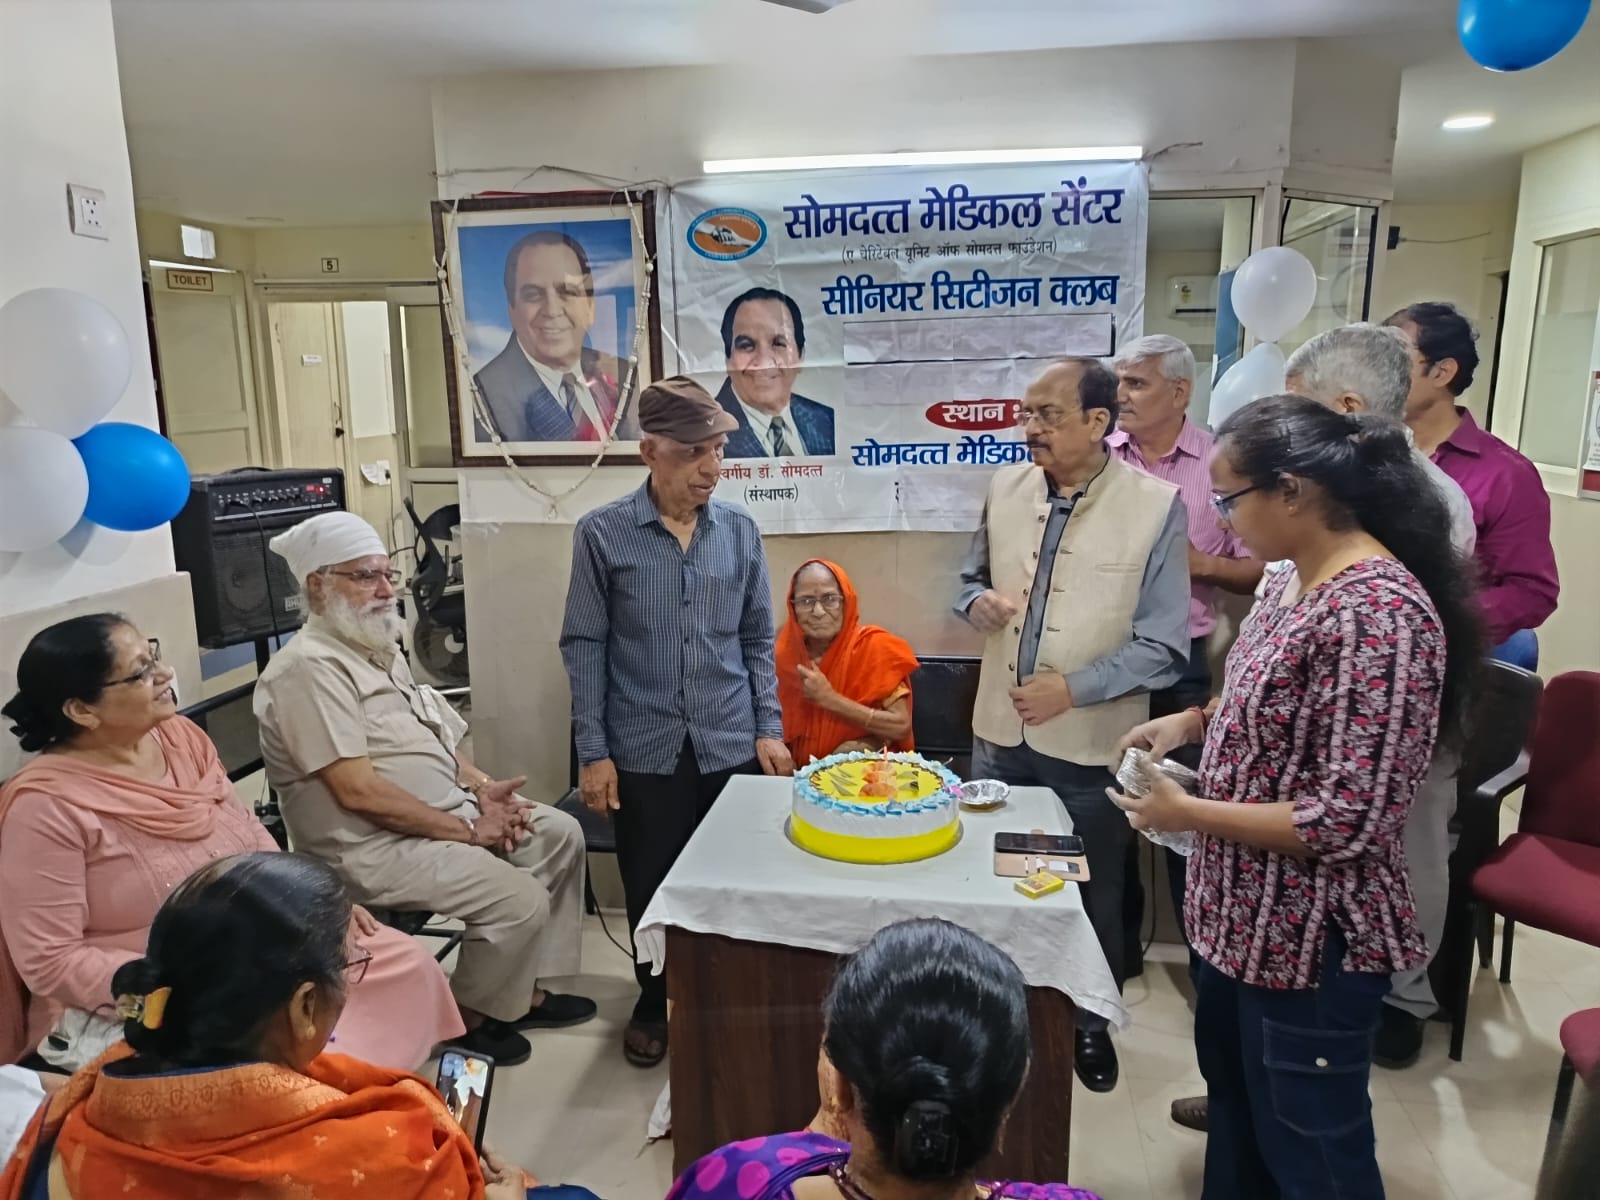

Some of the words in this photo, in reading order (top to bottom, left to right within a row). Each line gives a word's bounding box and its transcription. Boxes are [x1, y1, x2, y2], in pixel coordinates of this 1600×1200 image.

[783, 194, 911, 239] सोमदत्त
[919, 183, 1045, 232] मेडिकल
[1051, 175, 1125, 226] सेंटर
[905, 242, 930, 264] यूनिट
[937, 242, 960, 257] ऑफ
[966, 240, 1002, 256] सोमदत्त
[326, 260, 333, 271] 5
[173, 274, 207, 286] TOILET
[821, 274, 925, 315] सीनियर
[931, 269, 1042, 310] सिटीजन
[1049, 275, 1120, 306] क्लब
[942, 403, 1005, 423] स्थान
[851, 438, 950, 466] सोमदत्त
[956, 434, 1034, 464] मेडिक
[780, 461, 823, 478] सोमदत्त
[744, 483, 798, 504] (संस्थापक)
